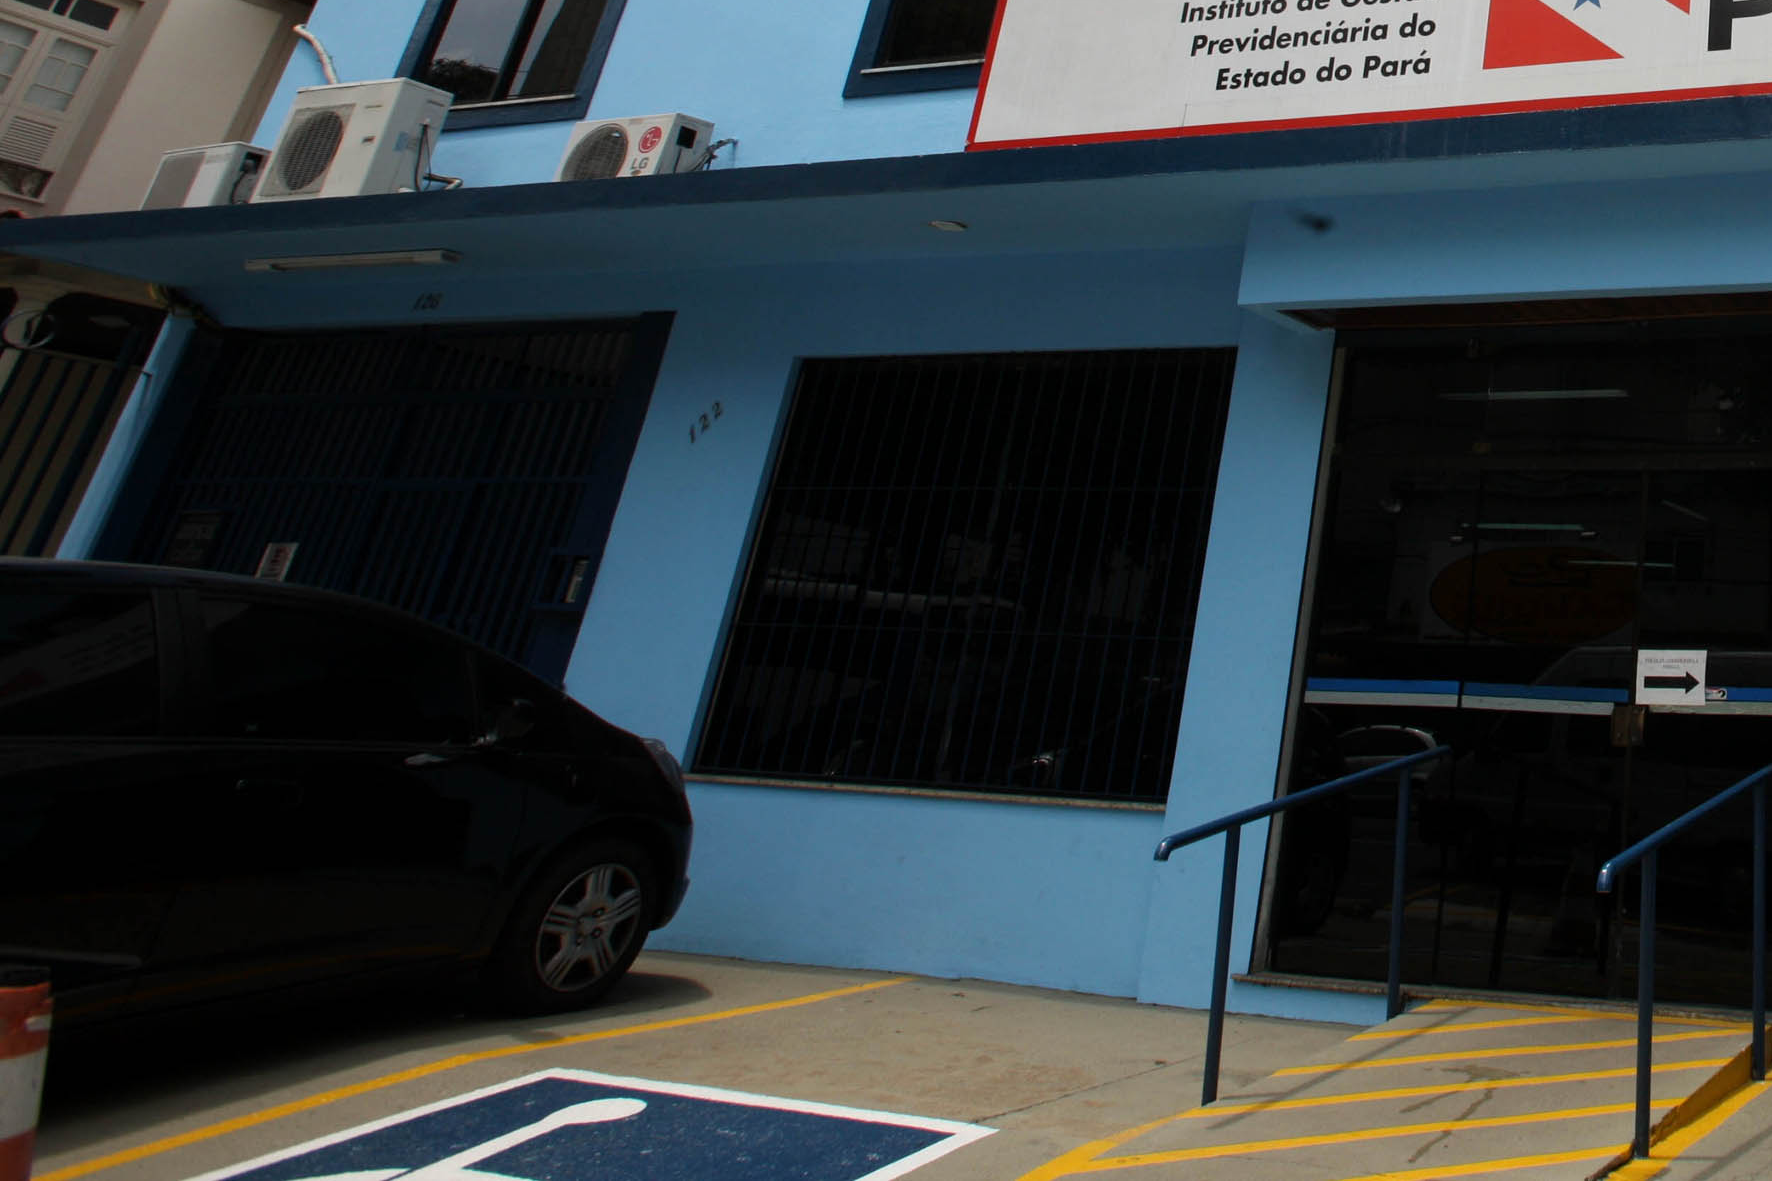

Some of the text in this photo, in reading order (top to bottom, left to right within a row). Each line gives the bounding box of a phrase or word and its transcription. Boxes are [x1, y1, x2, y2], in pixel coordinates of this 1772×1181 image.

[1190, 12, 1436, 57] Previdenciária do
[1215, 49, 1432, 91] Estado do Pará
[630, 157, 649, 170] LG
